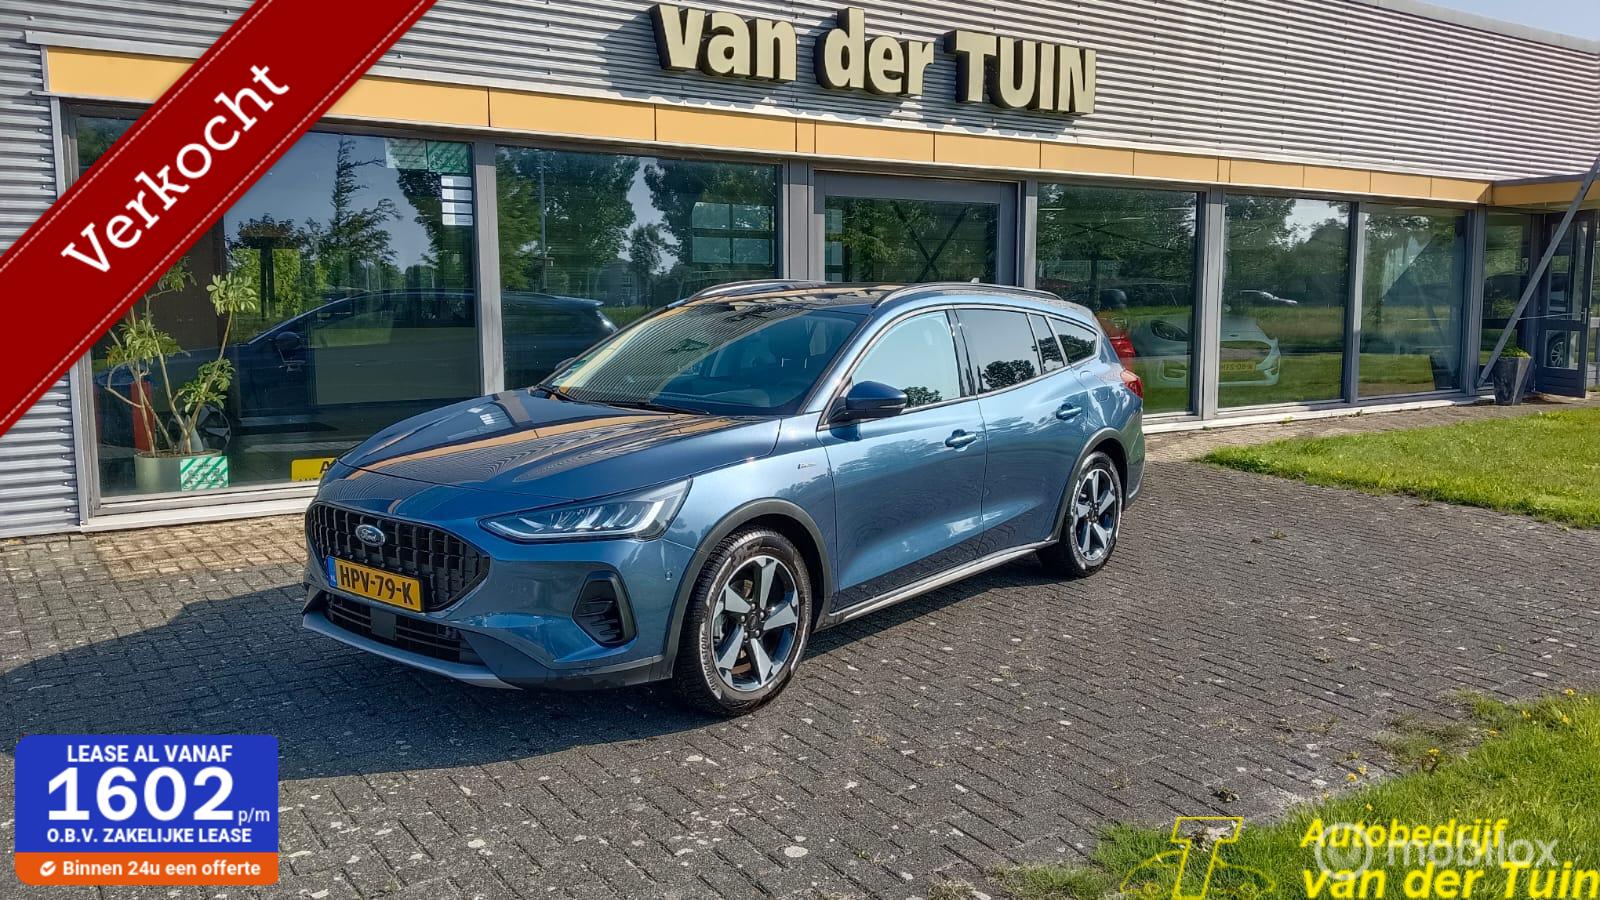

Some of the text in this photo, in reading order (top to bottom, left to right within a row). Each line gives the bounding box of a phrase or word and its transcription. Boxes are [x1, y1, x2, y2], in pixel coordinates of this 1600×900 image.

[652, 3, 1097, 114] van der TUIN
[339, 564, 414, 605] HPV-79-K
